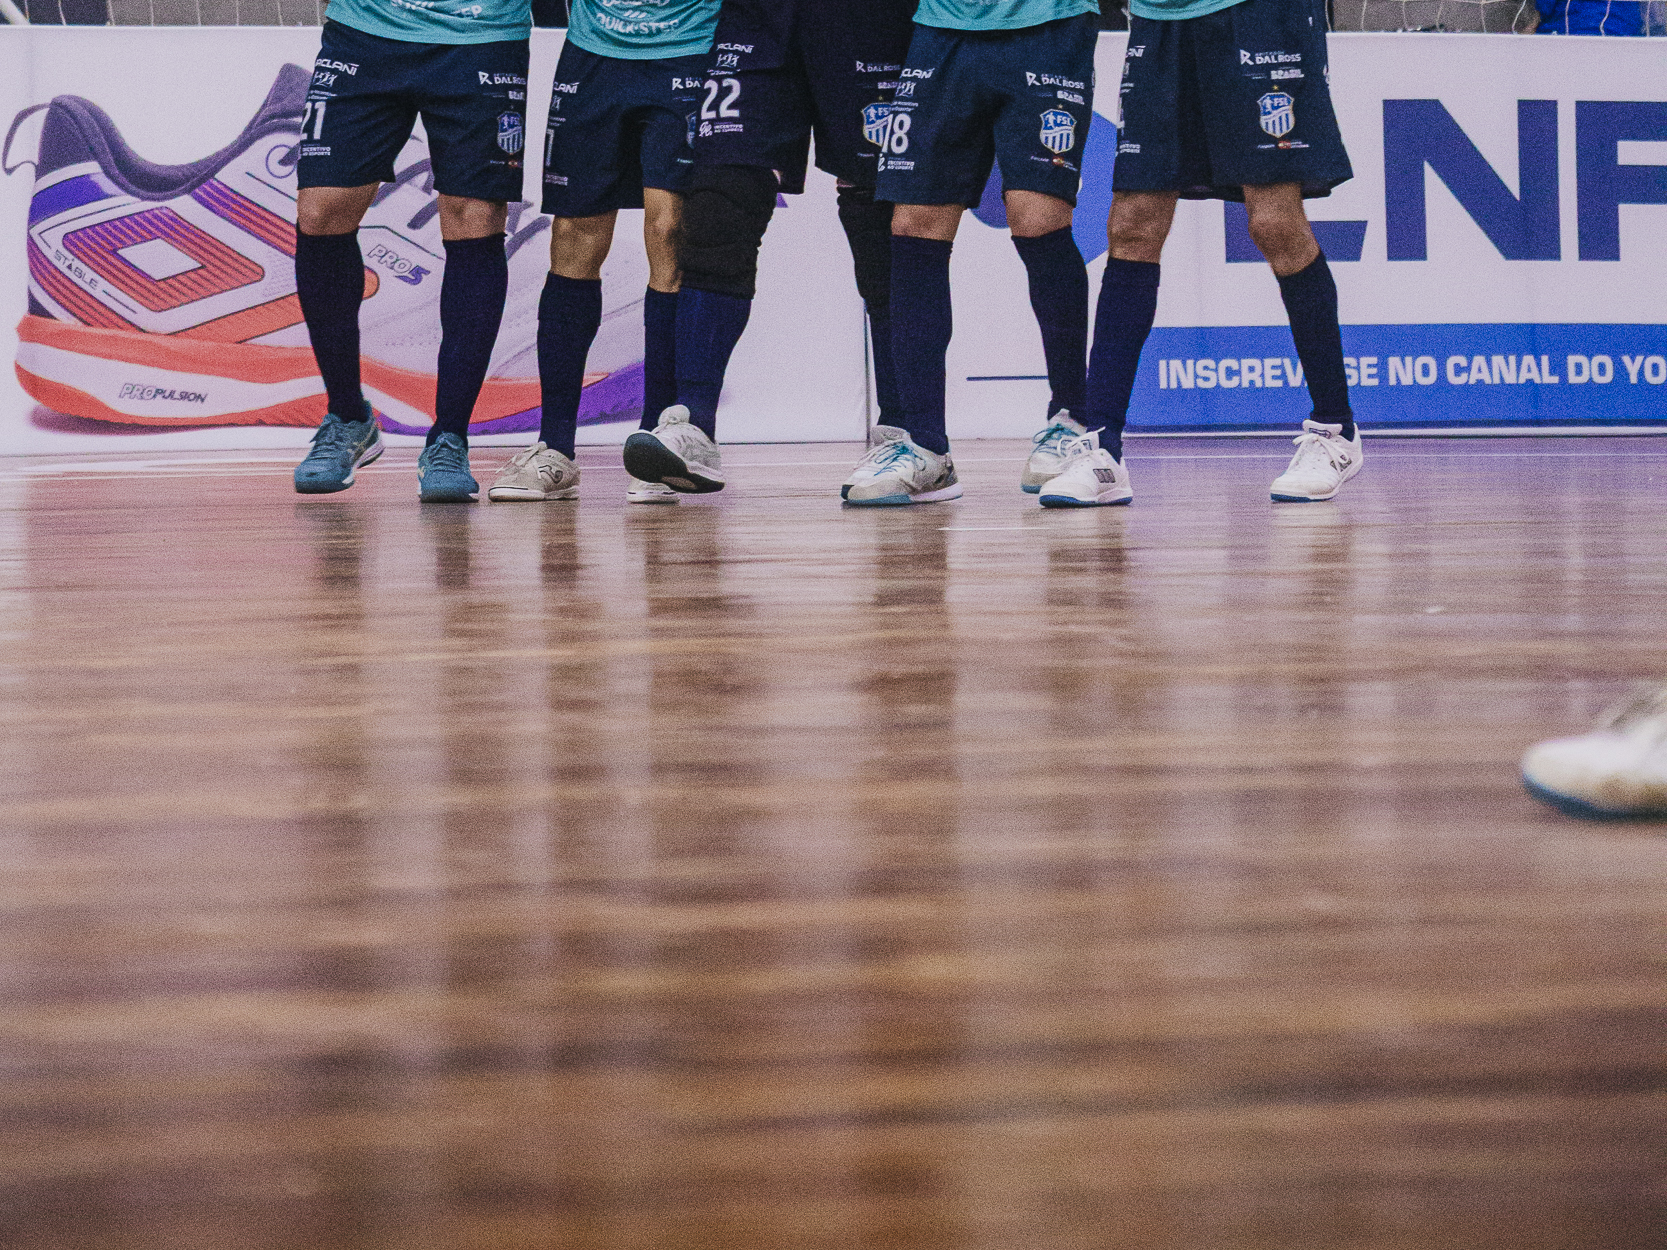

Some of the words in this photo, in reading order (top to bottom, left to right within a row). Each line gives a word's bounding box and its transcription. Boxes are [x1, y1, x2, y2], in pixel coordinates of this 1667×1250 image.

[701, 77, 741, 120] 22
[300, 101, 327, 140] 21
[53, 249, 99, 291] STABLE
[1387, 355, 1438, 387] NO
[1446, 354, 1560, 386] CANAL
[1566, 354, 1615, 385] DO
[118, 382, 209, 404] PROPULSION
